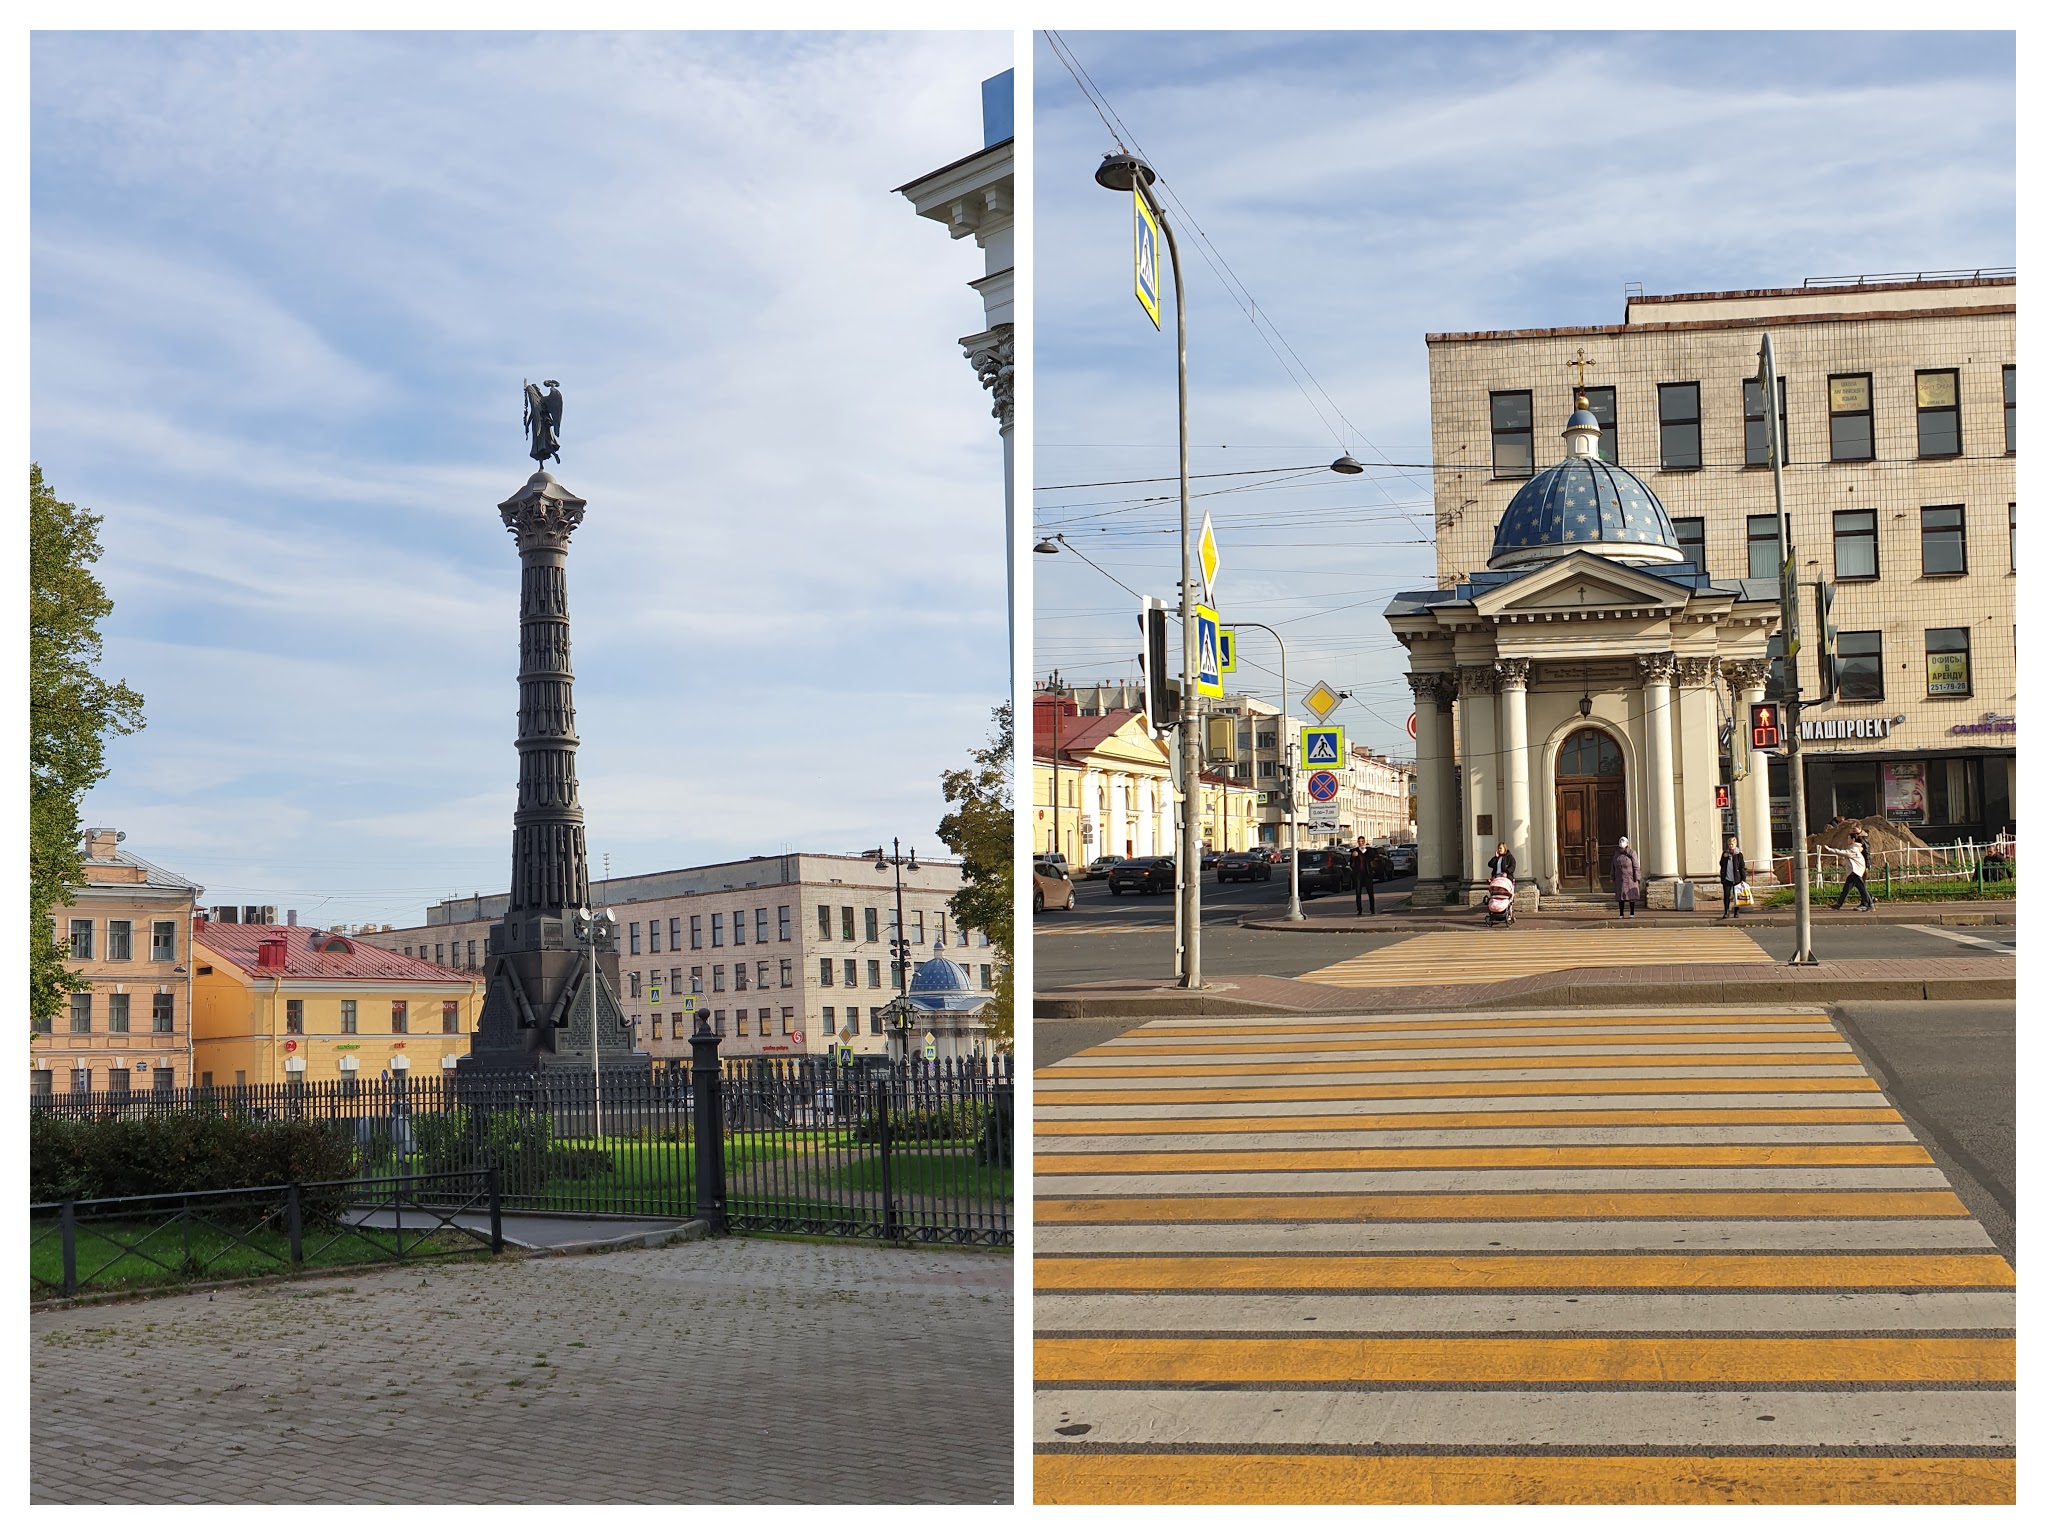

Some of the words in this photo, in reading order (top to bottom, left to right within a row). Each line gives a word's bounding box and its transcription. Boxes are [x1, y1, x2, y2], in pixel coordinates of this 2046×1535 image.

[1932, 656, 1962, 664] ОФИСЫ
[1932, 672, 1963, 680] АРЕНДУ
[1952, 724, 1992, 734] САЛОН
[1754, 727, 1777, 746] 07
